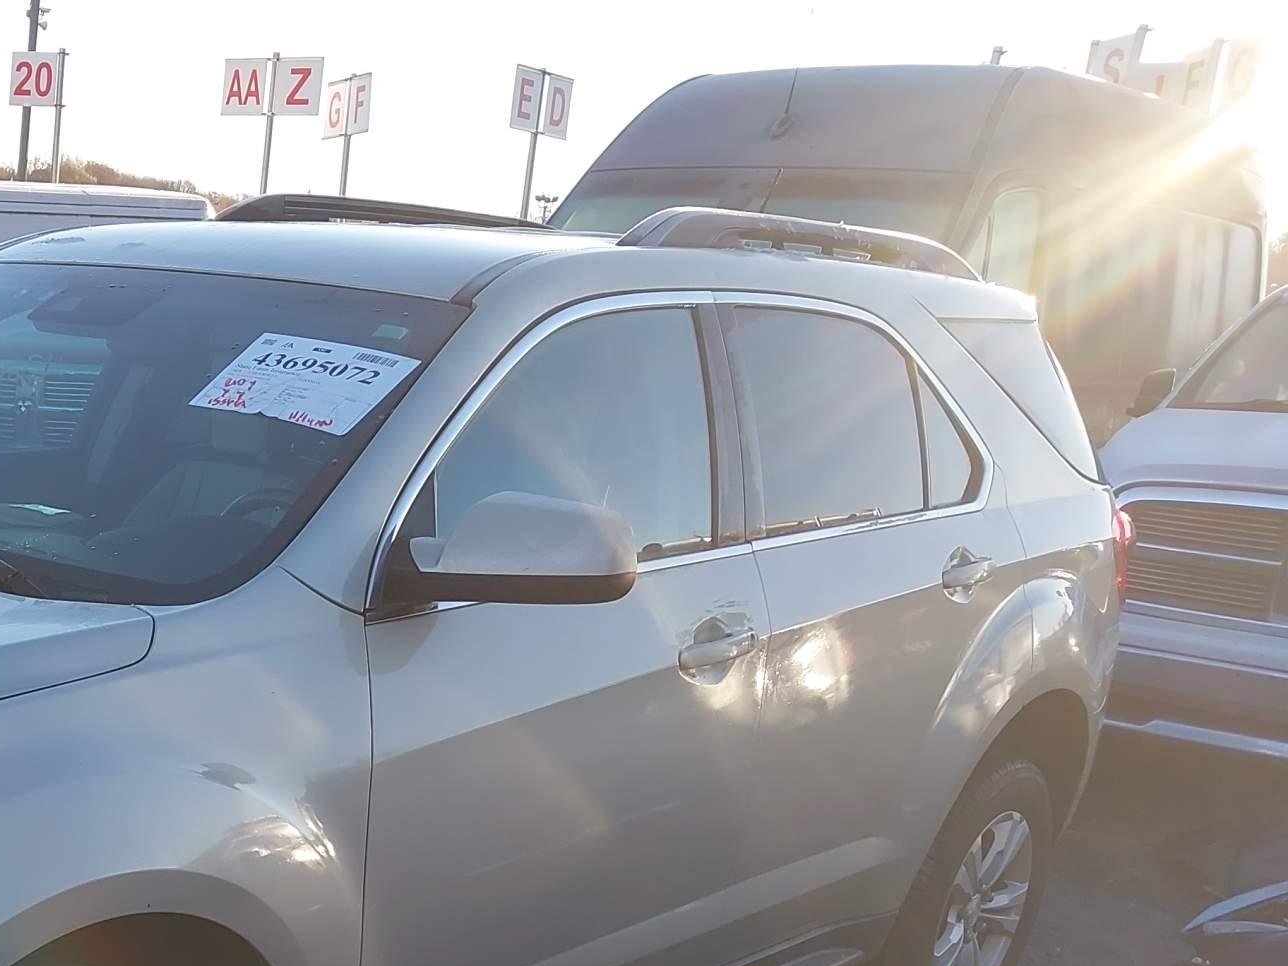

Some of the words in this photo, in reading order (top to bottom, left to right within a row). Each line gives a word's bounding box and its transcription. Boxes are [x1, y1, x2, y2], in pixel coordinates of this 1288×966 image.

[14, 61, 53, 97] 20
[225, 69, 260, 105] AA
[286, 68, 312, 105] Z
[329, 91, 342, 128] G
[354, 85, 366, 124] F
[517, 78, 535, 120] E
[549, 87, 566, 126] D
[252, 352, 381, 385] 43695072
